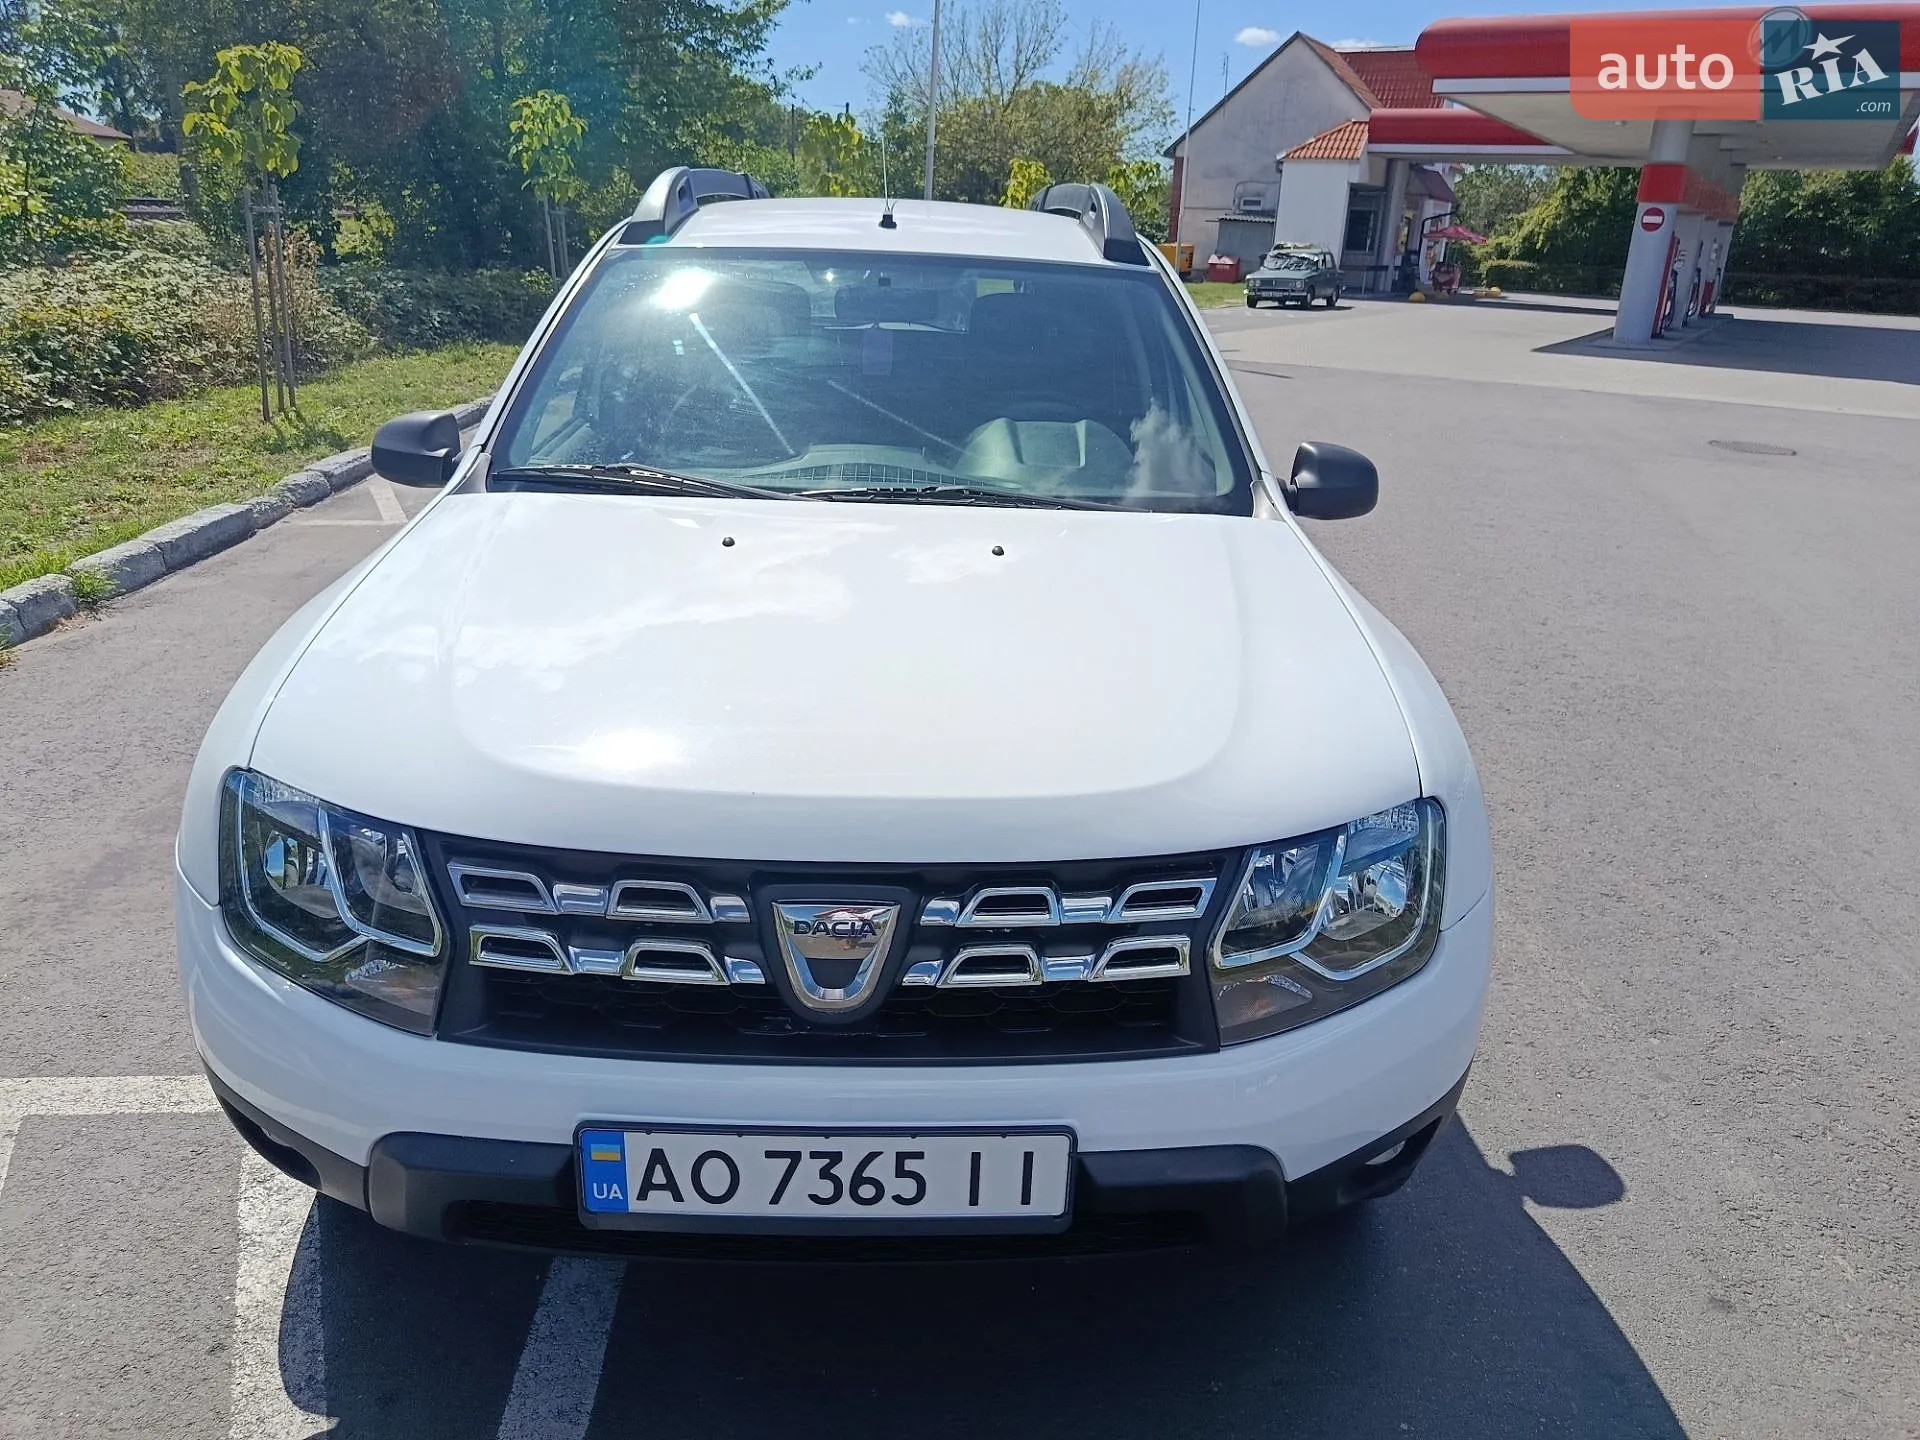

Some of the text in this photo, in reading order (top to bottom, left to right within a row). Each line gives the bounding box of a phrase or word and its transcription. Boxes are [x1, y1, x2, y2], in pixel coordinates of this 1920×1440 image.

[793, 919, 877, 937] DACIA
[636, 1148, 741, 1205] AO
[764, 1150, 926, 1206] 7365
[592, 1182, 624, 1200] UA
